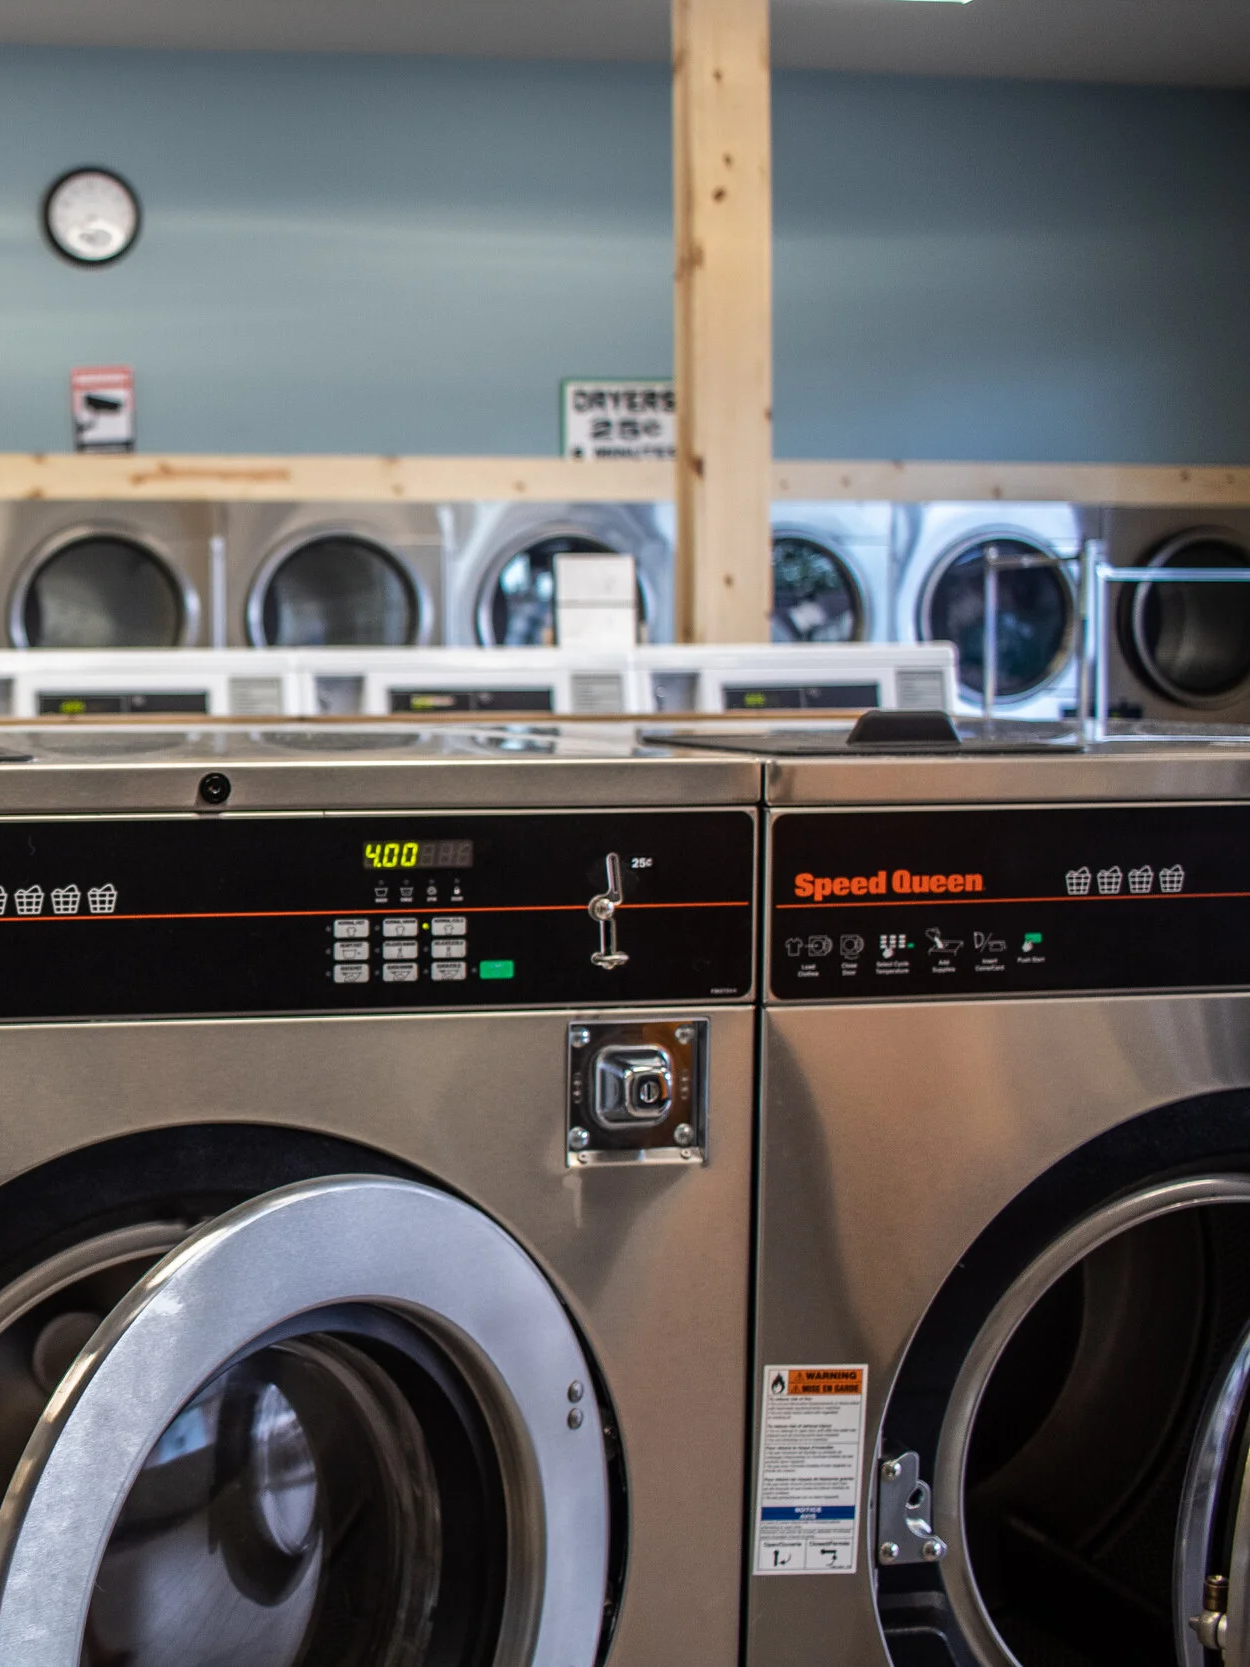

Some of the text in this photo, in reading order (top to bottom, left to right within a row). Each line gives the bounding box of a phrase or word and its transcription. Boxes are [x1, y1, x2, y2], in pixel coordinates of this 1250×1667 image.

[365, 842, 418, 868] 4.00
[631, 857, 653, 869] 25¢
[794, 869, 984, 901] Speed Queen
[806, 1371, 857, 1380] WARNING
